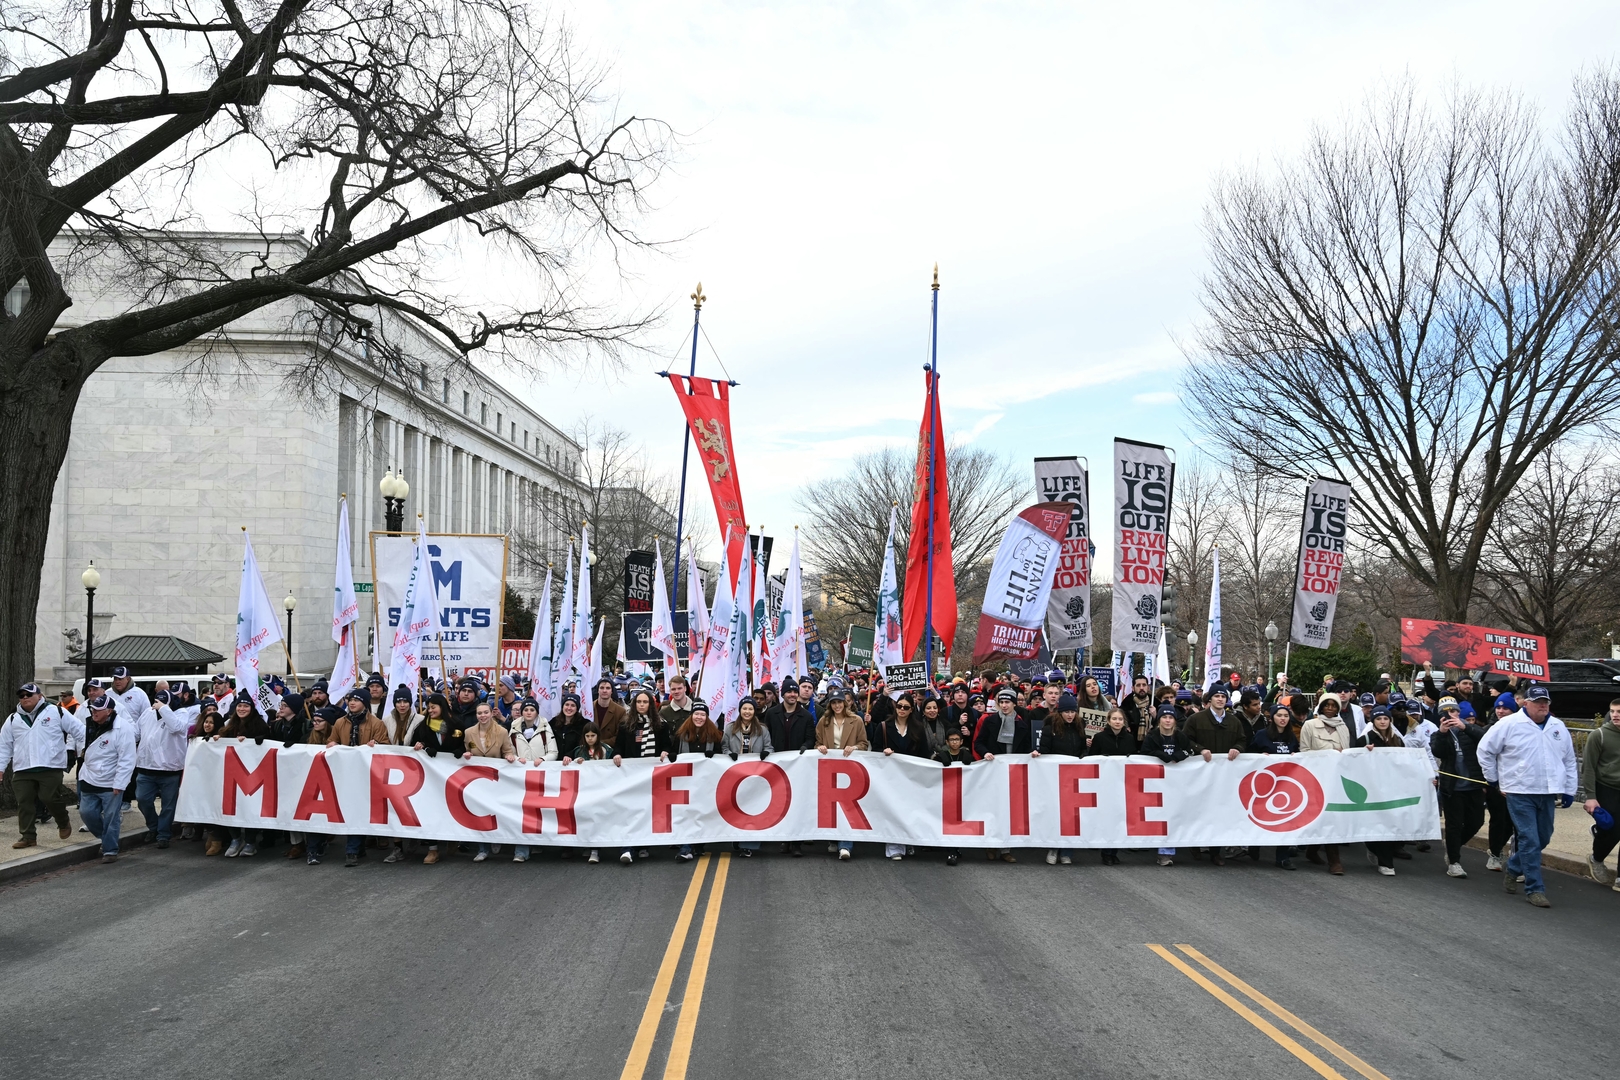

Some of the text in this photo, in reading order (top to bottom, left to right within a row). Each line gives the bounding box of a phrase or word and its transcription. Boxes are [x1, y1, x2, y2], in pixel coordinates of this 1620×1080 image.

[1121, 460, 1165, 481] LIFE
[1042, 476, 1081, 492] LIFE
[1120, 478, 1166, 514] IS
[1311, 492, 1346, 511] LIFE
[1120, 510, 1165, 532] OUR
[1308, 508, 1346, 538] IS
[1060, 538, 1088, 554] EVO
[1120, 530, 1165, 550] REVO
[1306, 534, 1344, 552] OUR
[1022, 558, 1034, 573] for
[1121, 546, 1166, 568] LUT
[1304, 548, 1343, 566] REVO
[628, 564, 650, 574] DEATH
[1120, 565, 1164, 586] ION
[1303, 562, 1342, 581] LUT
[630, 572, 650, 590] IS
[1026, 554, 1048, 604] TITANS
[1052, 570, 1088, 589] ION
[1300, 575, 1340, 596] ION
[628, 588, 650, 600] NOT
[1002, 570, 1028, 619] LIFE
[628, 598, 651, 610] WEL
[388, 608, 490, 628] SNTS
[994, 624, 1038, 640] TRINITY
[991, 636, 1034, 650] HIGH SCHOOL
[1486, 634, 1537, 650] IN THE FACE
[852, 647, 872, 658] TRINITY
[1492, 647, 1532, 662] OF EVIL,
[1496, 659, 1543, 676] WE STAND
[887, 672, 926, 682] PRO-LIFE
[888, 680, 926, 688] GENERATION
[222, 746, 1168, 836] MARCH FOR LIFE
